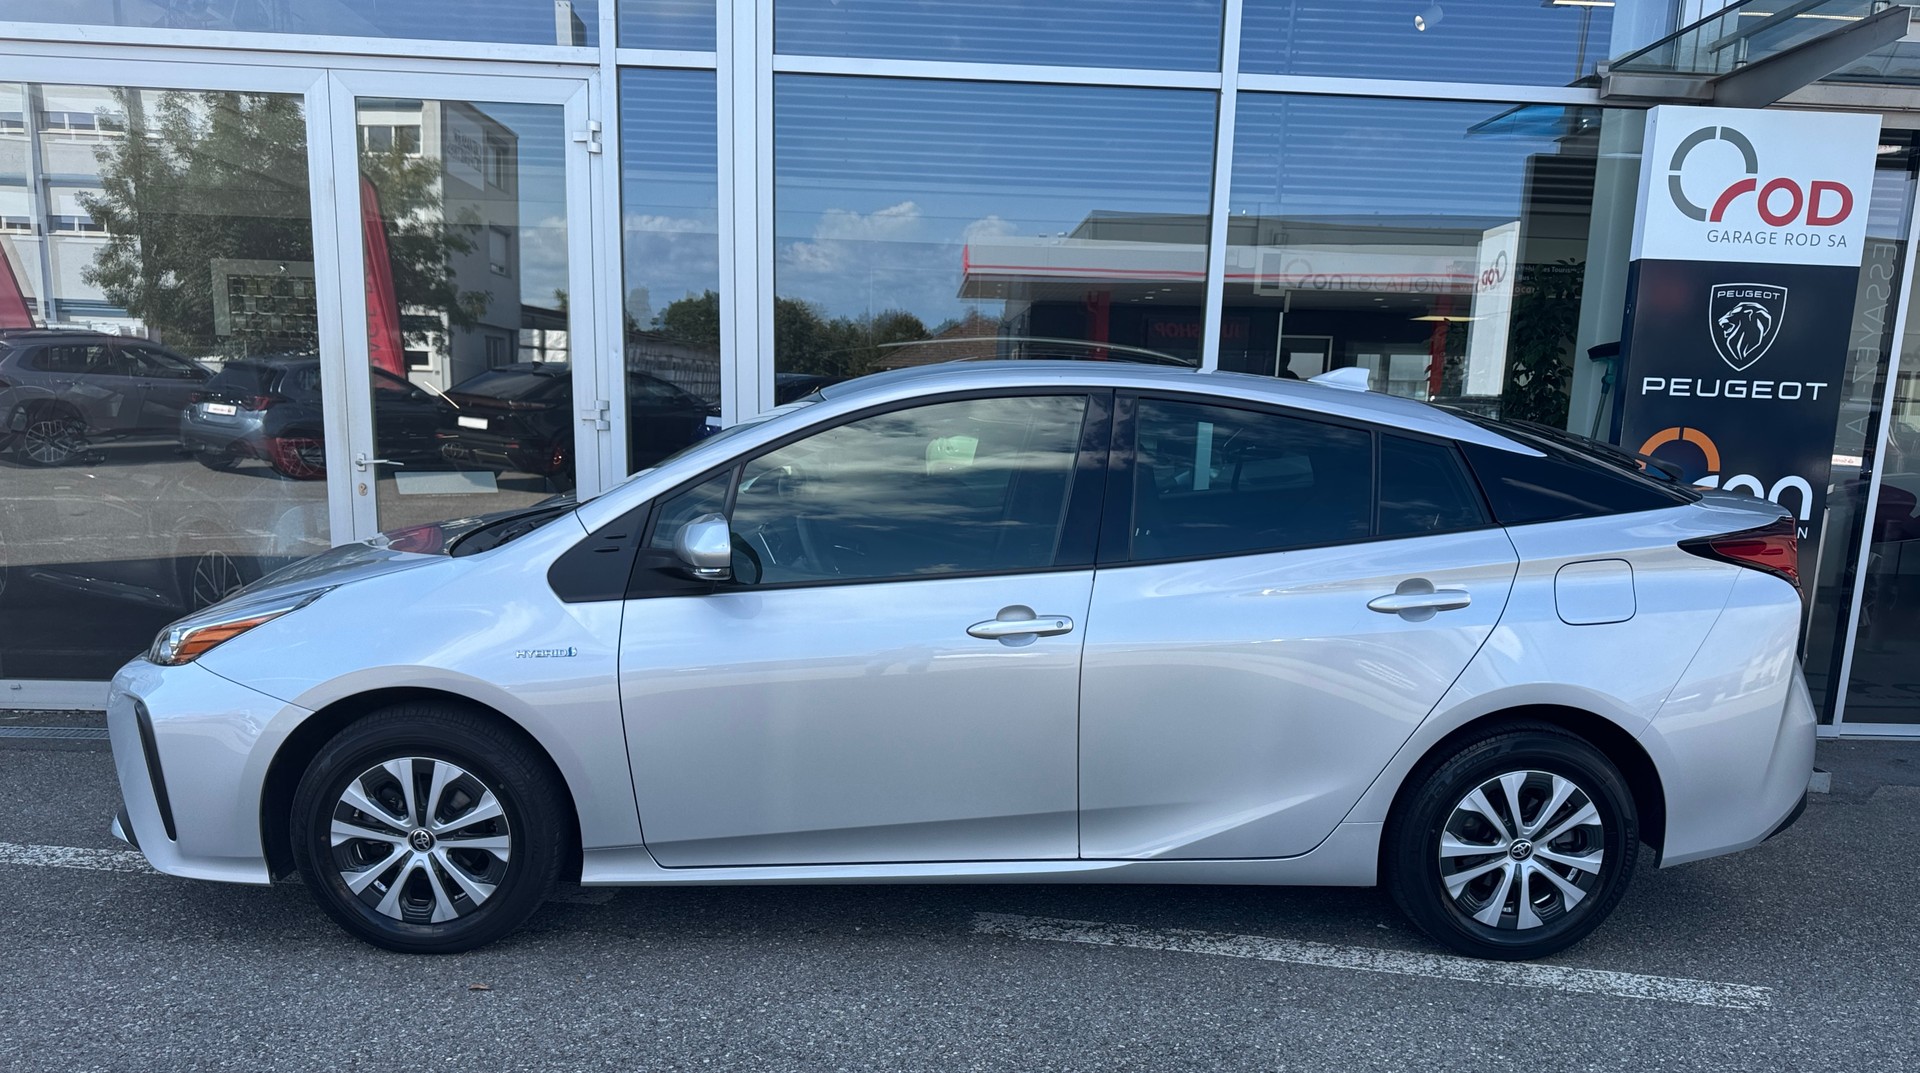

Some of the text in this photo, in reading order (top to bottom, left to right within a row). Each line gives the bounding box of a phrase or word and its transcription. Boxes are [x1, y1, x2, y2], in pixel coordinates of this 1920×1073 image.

[1706, 229, 1848, 249] GARAGE ROD SA
[1716, 289, 1781, 300] PEUGEOT
[1641, 376, 1828, 401] PEUGEOT
[515, 648, 568, 659] HYBRID
